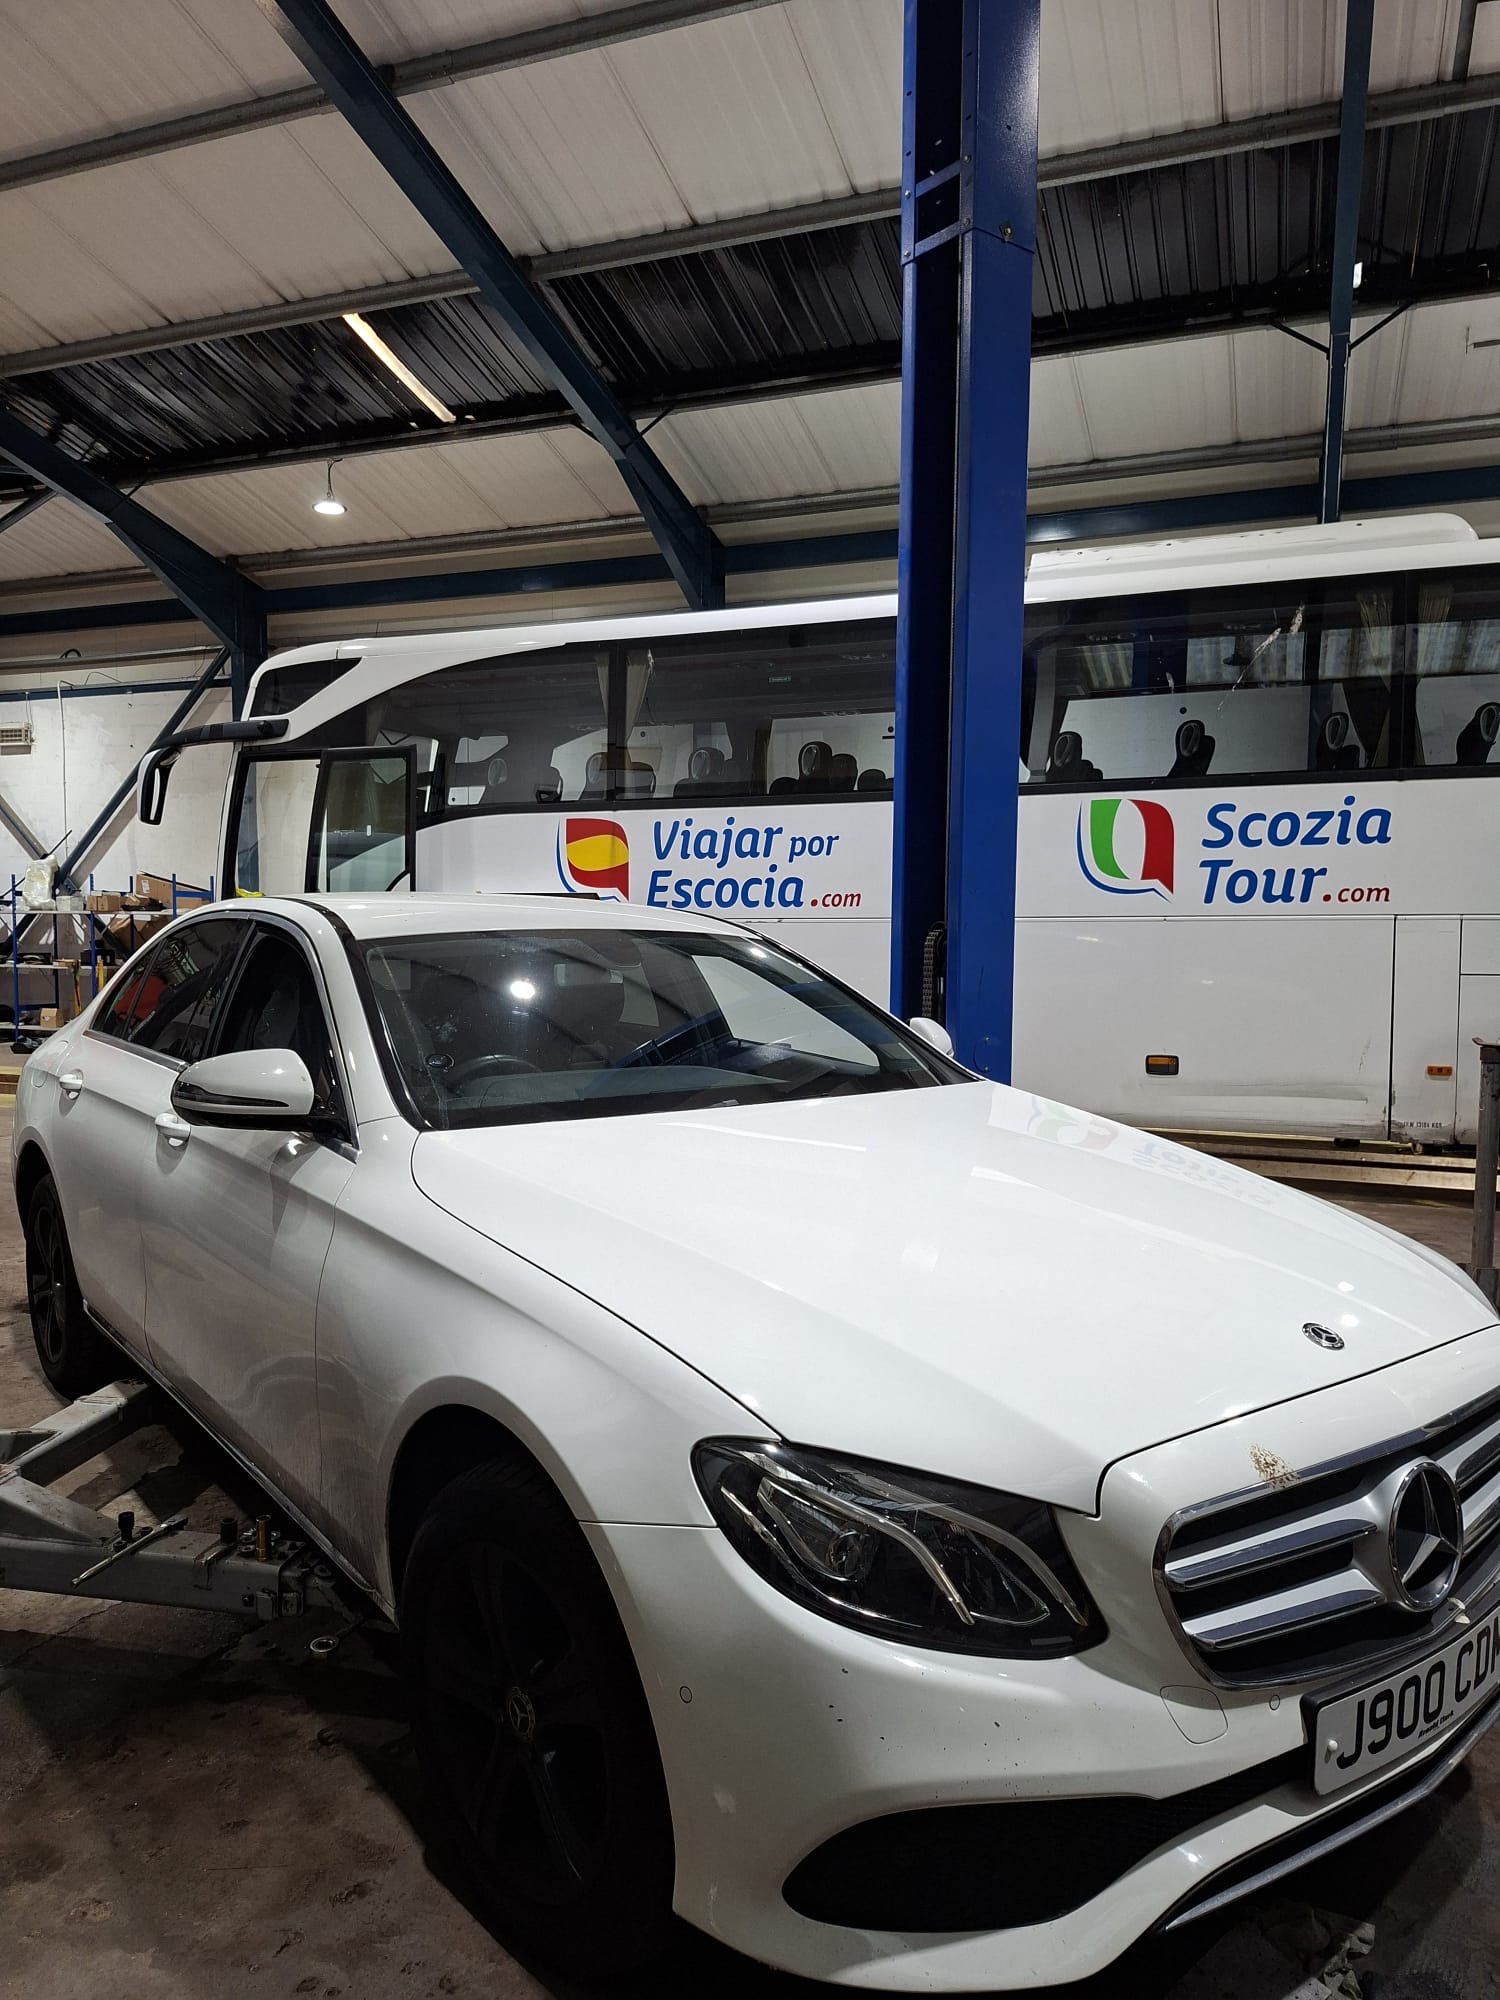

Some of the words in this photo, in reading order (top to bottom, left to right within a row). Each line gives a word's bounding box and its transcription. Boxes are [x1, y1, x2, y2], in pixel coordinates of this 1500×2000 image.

[653, 816, 783, 869] Viajar
[788, 833, 840, 863] por
[1201, 795, 1392, 849] Scozia
[1336, 1660, 1446, 1770] J900
